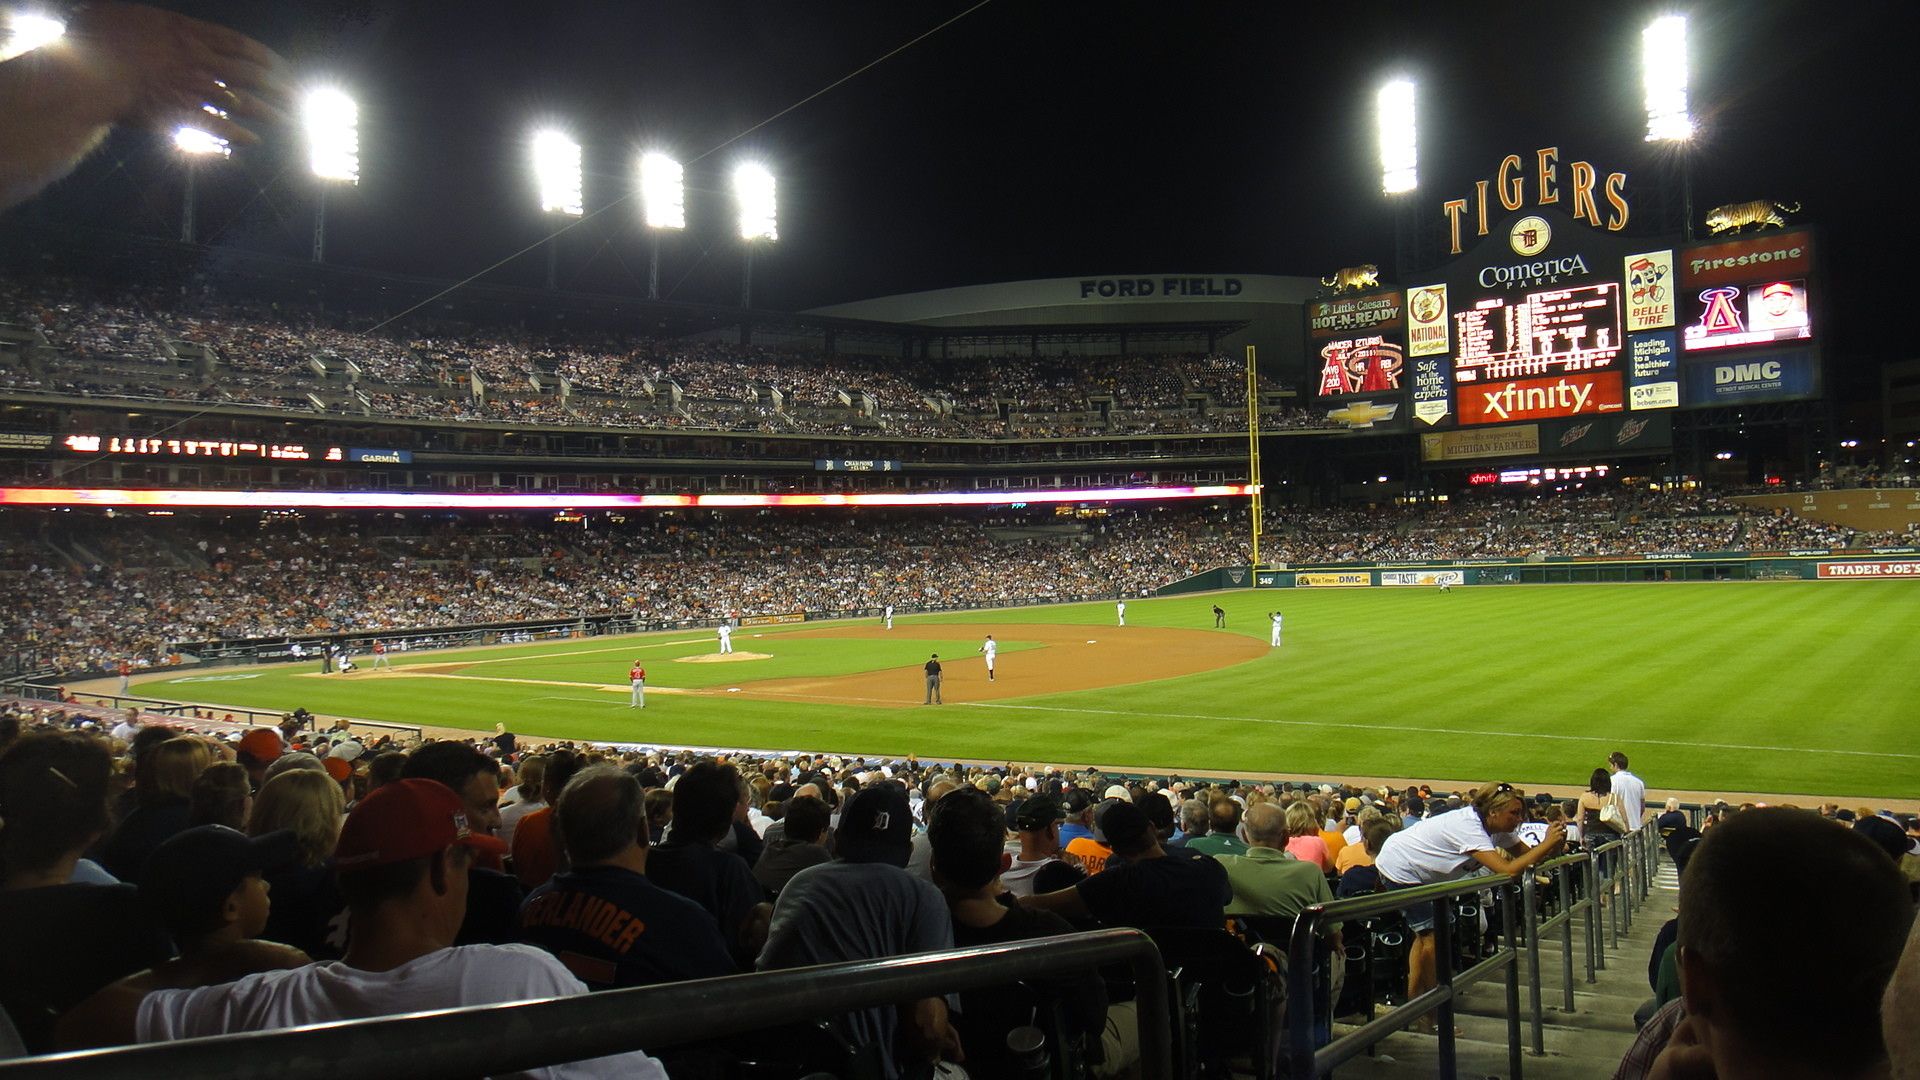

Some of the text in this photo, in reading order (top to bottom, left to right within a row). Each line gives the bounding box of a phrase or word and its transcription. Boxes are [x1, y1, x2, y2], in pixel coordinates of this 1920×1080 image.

[1444, 147, 1629, 254] TIGERS
[1691, 247, 1802, 275] Firestone
[1080, 278, 1242, 298] FORD FIELD
[1507, 276, 1558, 290] PARK
[1333, 299, 1391, 314] Little Caesars
[1632, 304, 1668, 317] BELLE
[1312, 307, 1399, 329] HOT-N-READY
[1637, 315, 1664, 326] TIRE
[1411, 325, 1447, 342] NATIONAL
[1634, 339, 1666, 349] Leading
[1634, 346, 1670, 356] Michigan
[1416, 360, 1438, 372] Safe
[1634, 360, 1671, 370] healthier
[1634, 369, 1660, 377] future
[1715, 361, 1781, 385] DMC
[1416, 376, 1444, 387] home
[1414, 389, 1448, 400] experts
[1484, 379, 1594, 419] xfinity
[1447, 440, 1537, 455] MICHIGAN FARMERS
[361, 454, 400, 463] GARMIN
[1471, 474, 1497, 484] xfinity
[1804, 495, 1814, 504] 23
[1829, 563, 1920, 575] TRADER JOE'S
[1398, 574, 1418, 585] TASTE
